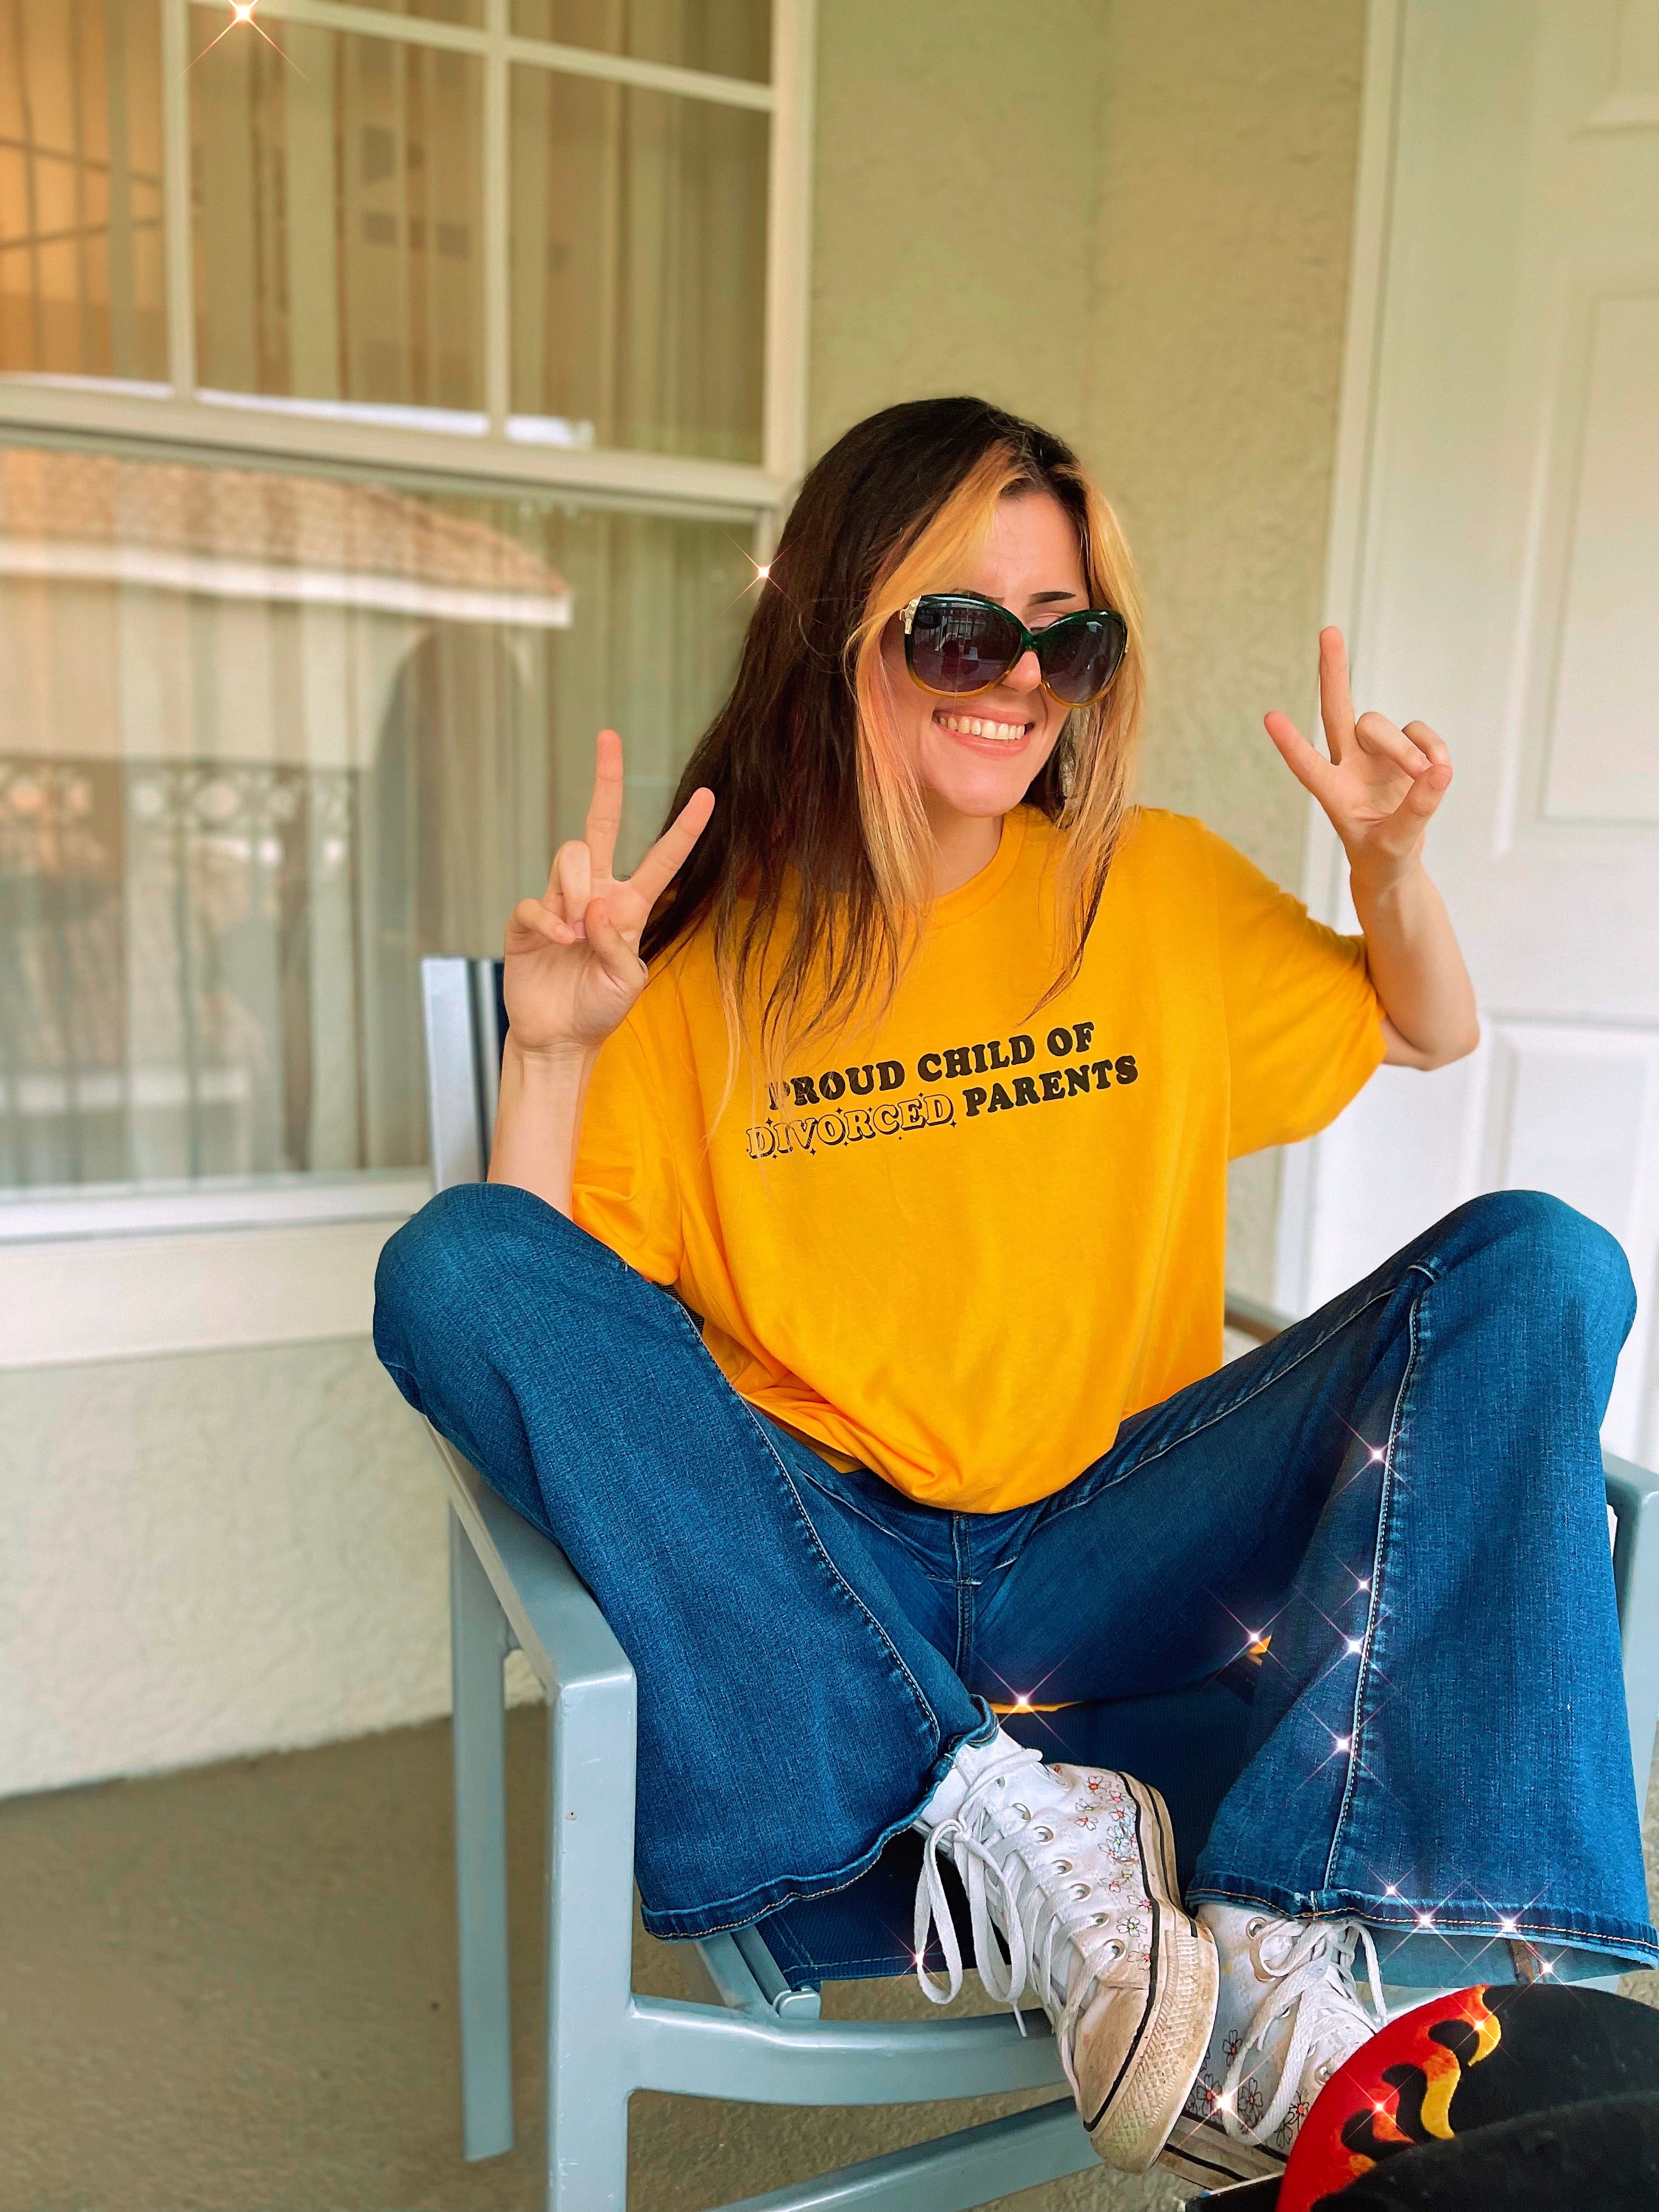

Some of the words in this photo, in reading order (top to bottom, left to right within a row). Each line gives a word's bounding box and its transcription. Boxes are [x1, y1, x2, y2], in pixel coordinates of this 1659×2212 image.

[918, 1035, 1035, 1082] CHILD
[1047, 1022, 1095, 1056] OF
[746, 1095, 953, 1159] DIVORCED
[962, 1056, 1138, 1116] PARENTS
